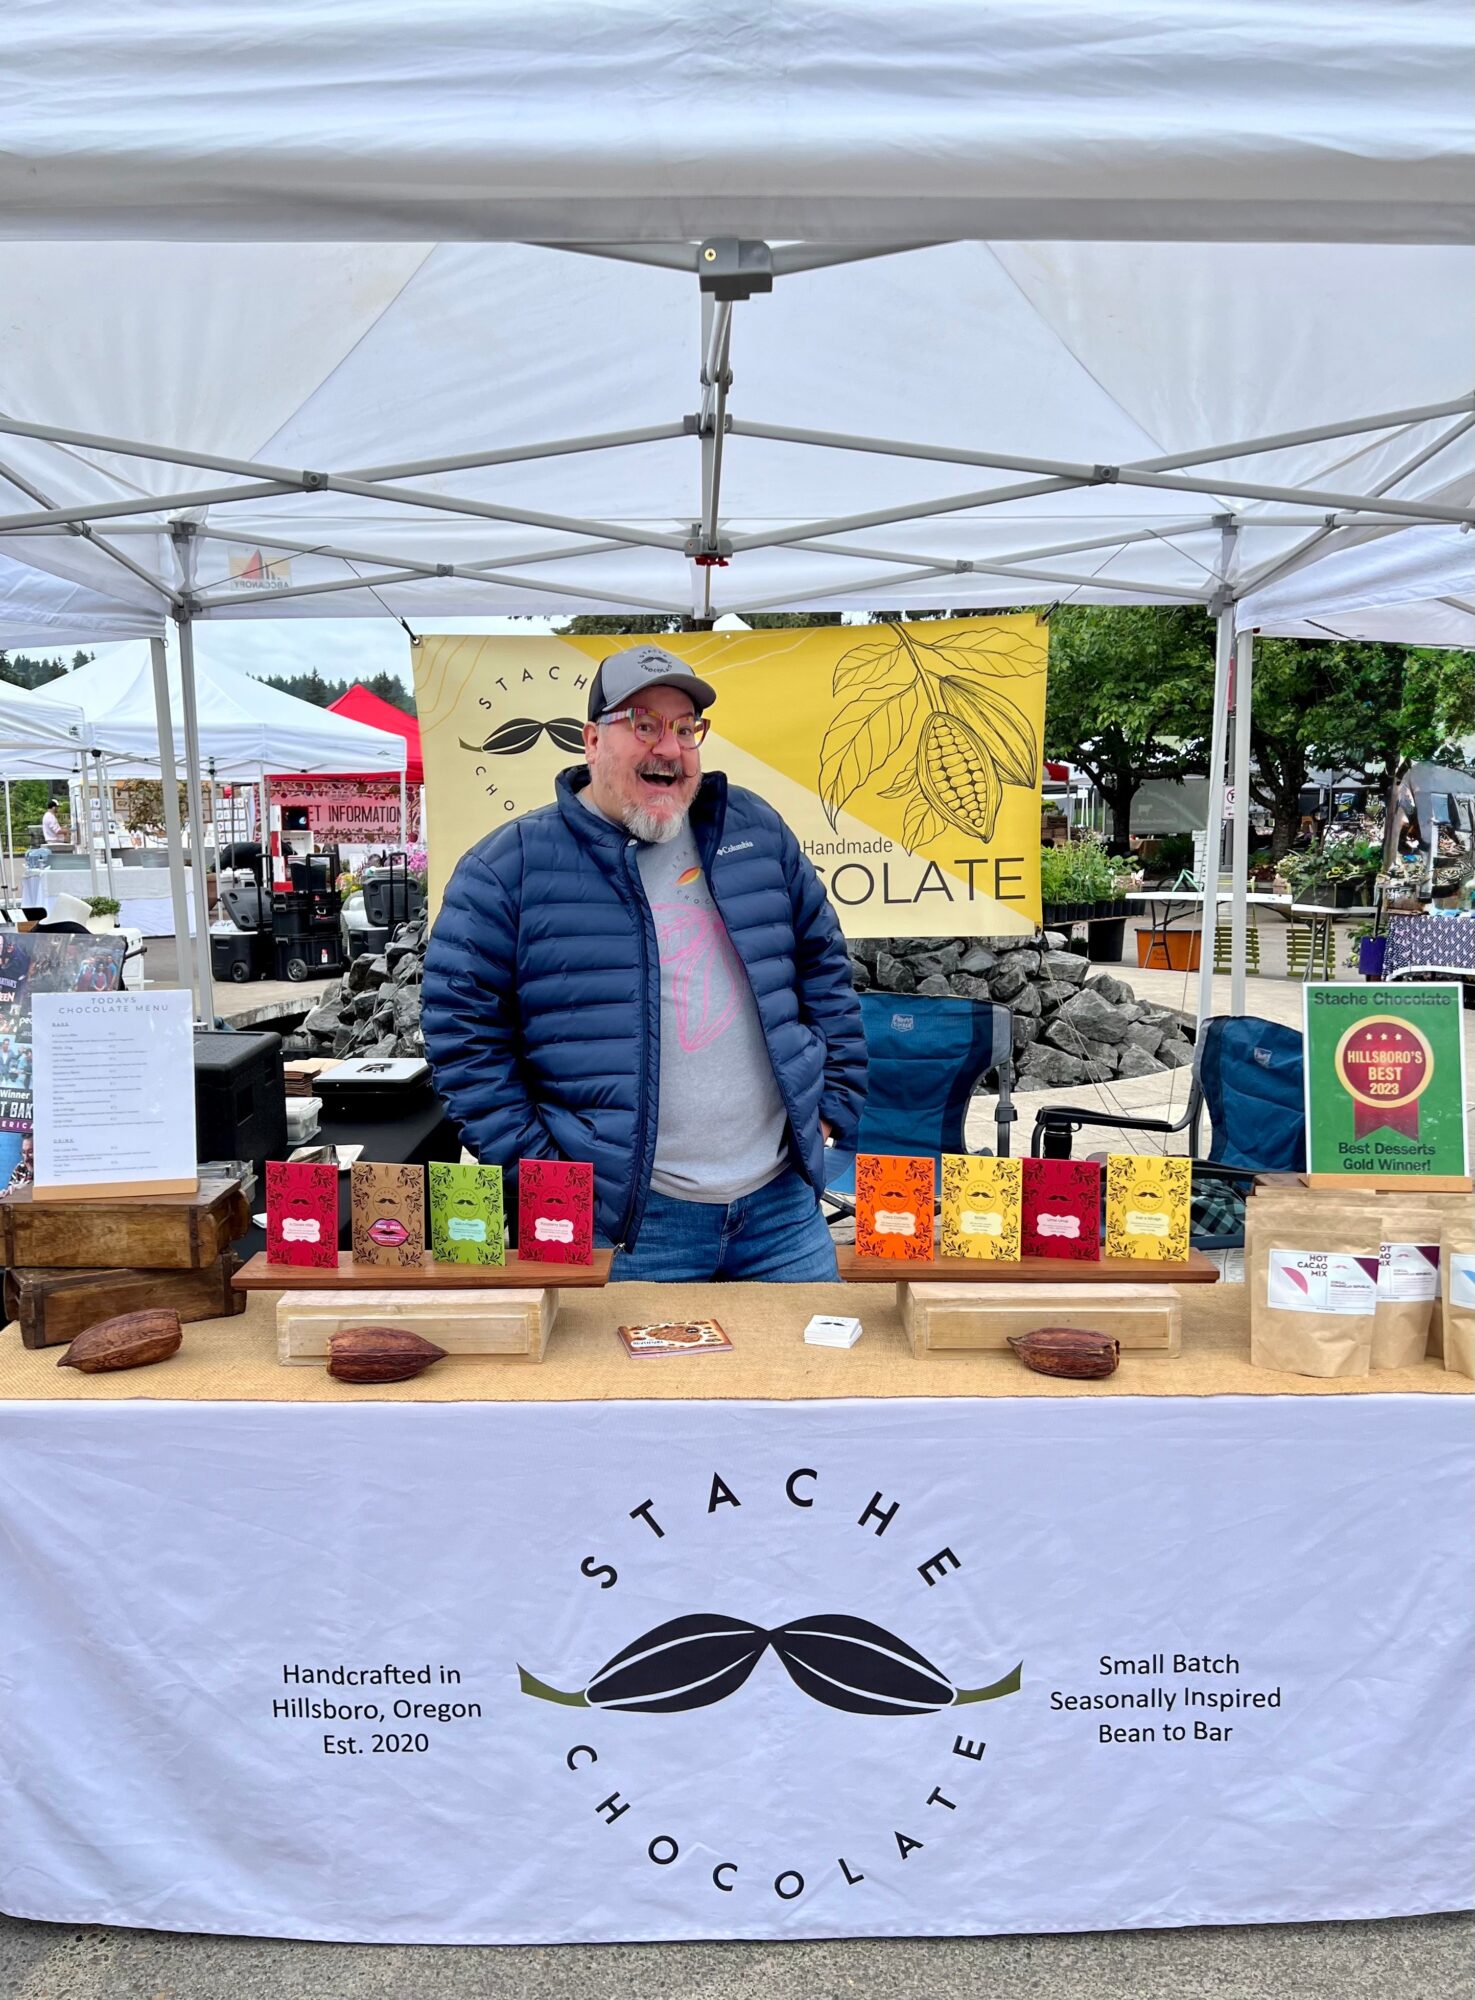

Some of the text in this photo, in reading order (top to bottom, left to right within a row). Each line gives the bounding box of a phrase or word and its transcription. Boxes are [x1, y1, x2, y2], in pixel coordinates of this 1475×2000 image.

[478, 665, 588, 711] STACH
[328, 804, 402, 823] INFORMATION
[721, 840, 754, 855] Columbia
[803, 837, 893, 855] Handmade
[815, 857, 1026, 906] OLATE
[0, 992, 15, 1002] EEN
[91, 997, 137, 1005] TODAYS
[1314, 992, 1452, 1006] Stache Chocolate
[58, 1004, 169, 1014] CHOCOLATE MENU
[1347, 1050, 1423, 1064] HILLSBORO'S
[1368, 1067, 1403, 1081] BEST
[0, 1089, 31, 1100] Winner
[1369, 1083, 1400, 1095] 2023
[9, 1101, 33, 1119] BAK
[1338, 1142, 1436, 1156] Best Desserts
[1343, 1158, 1431, 1172] Gold Winner!
[1297, 1261, 1328, 1270] CACAO
[1309, 1254, 1328, 1262] HOT
[1310, 1270, 1328, 1278] MIX
[580, 1467, 962, 1589] STACHE
[1099, 1653, 1240, 1676] Small Batch
[283, 1663, 461, 1686] Handcrafted in
[1050, 1687, 1281, 1712] Seasonally Inspired
[272, 1697, 482, 1723] Hillsboro, Oregon
[1099, 1721, 1233, 1743] Bean to Bar
[323, 1733, 430, 1755] Est. 2020
[566, 1735, 987, 1900] CHOCOLATE
